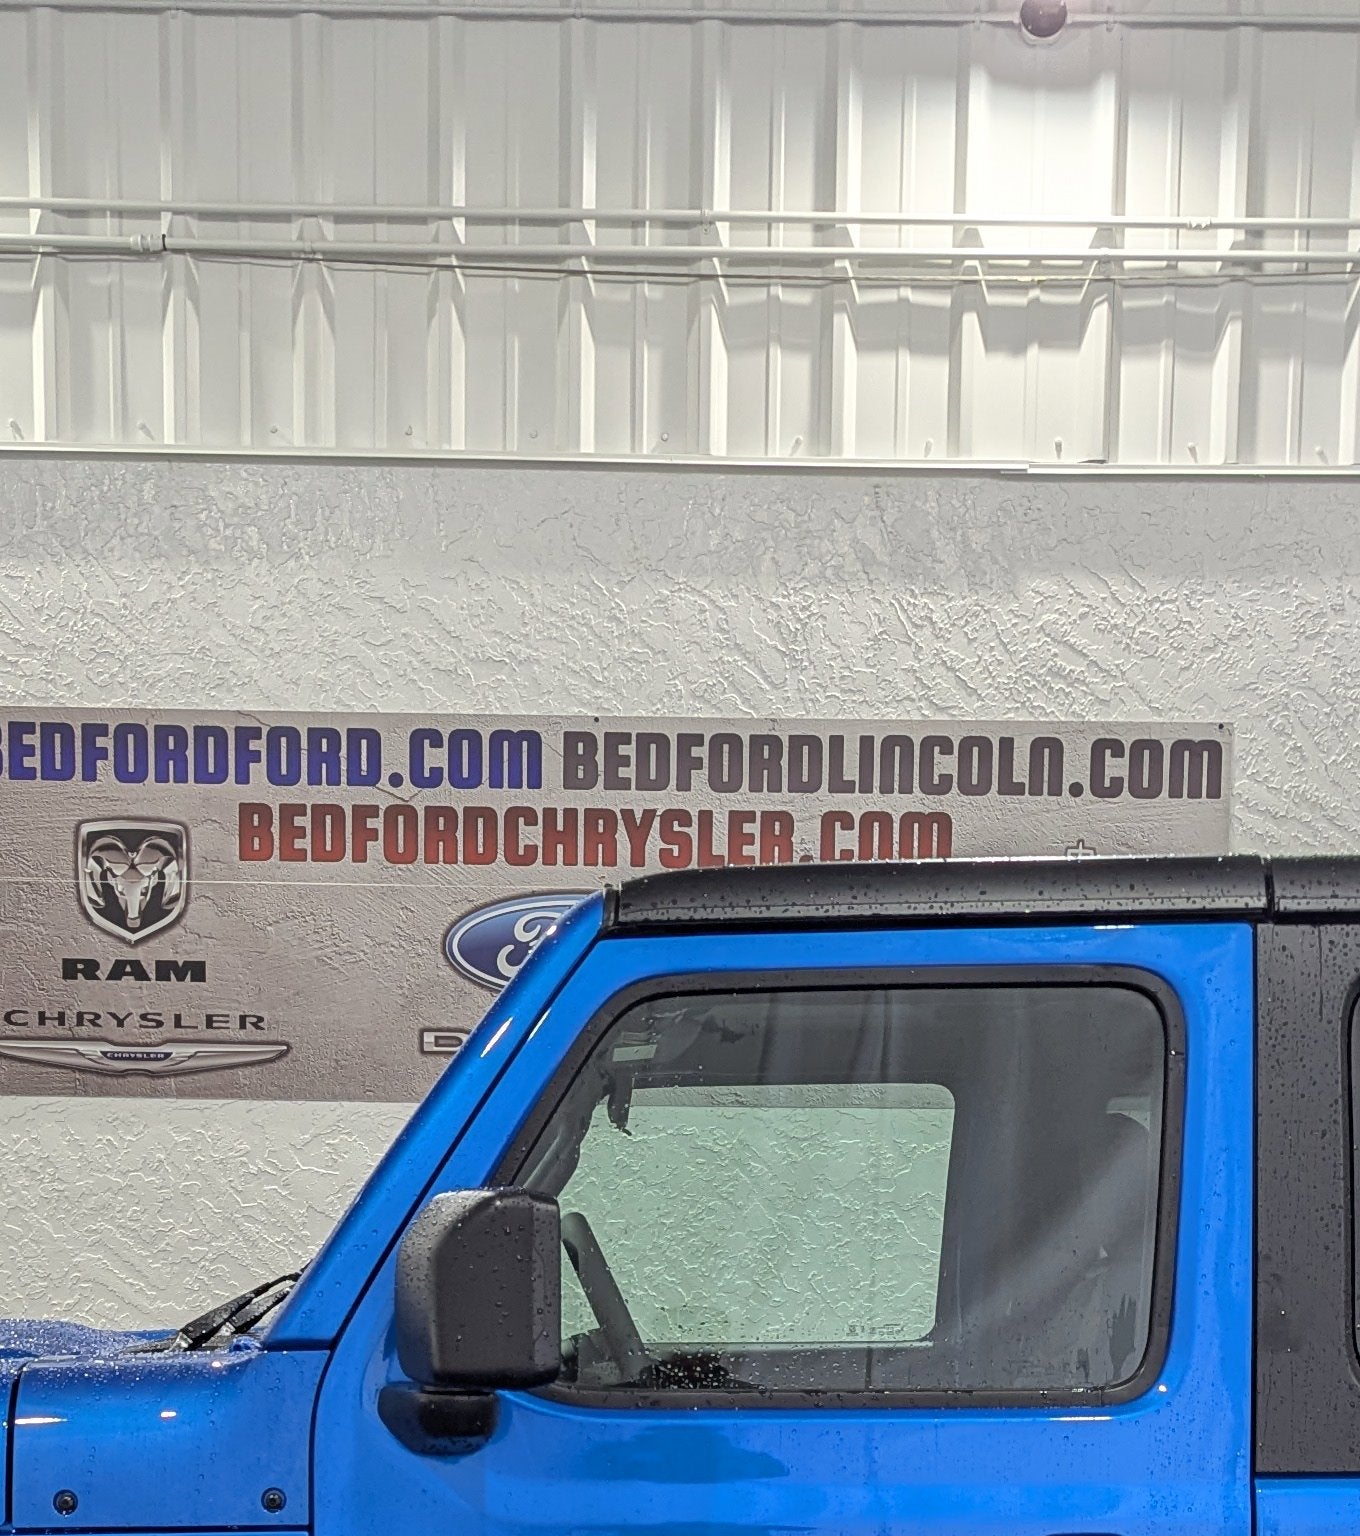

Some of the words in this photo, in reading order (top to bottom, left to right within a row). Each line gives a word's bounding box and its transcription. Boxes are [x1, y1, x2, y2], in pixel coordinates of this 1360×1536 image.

[562, 731, 1223, 799] BEDFORDLINCOLN.COM
[238, 802, 953, 869] BEDFORDCHRYSLER.COM
[61, 957, 207, 983] RAM
[3, 1008, 267, 1031] CHRYSLER
